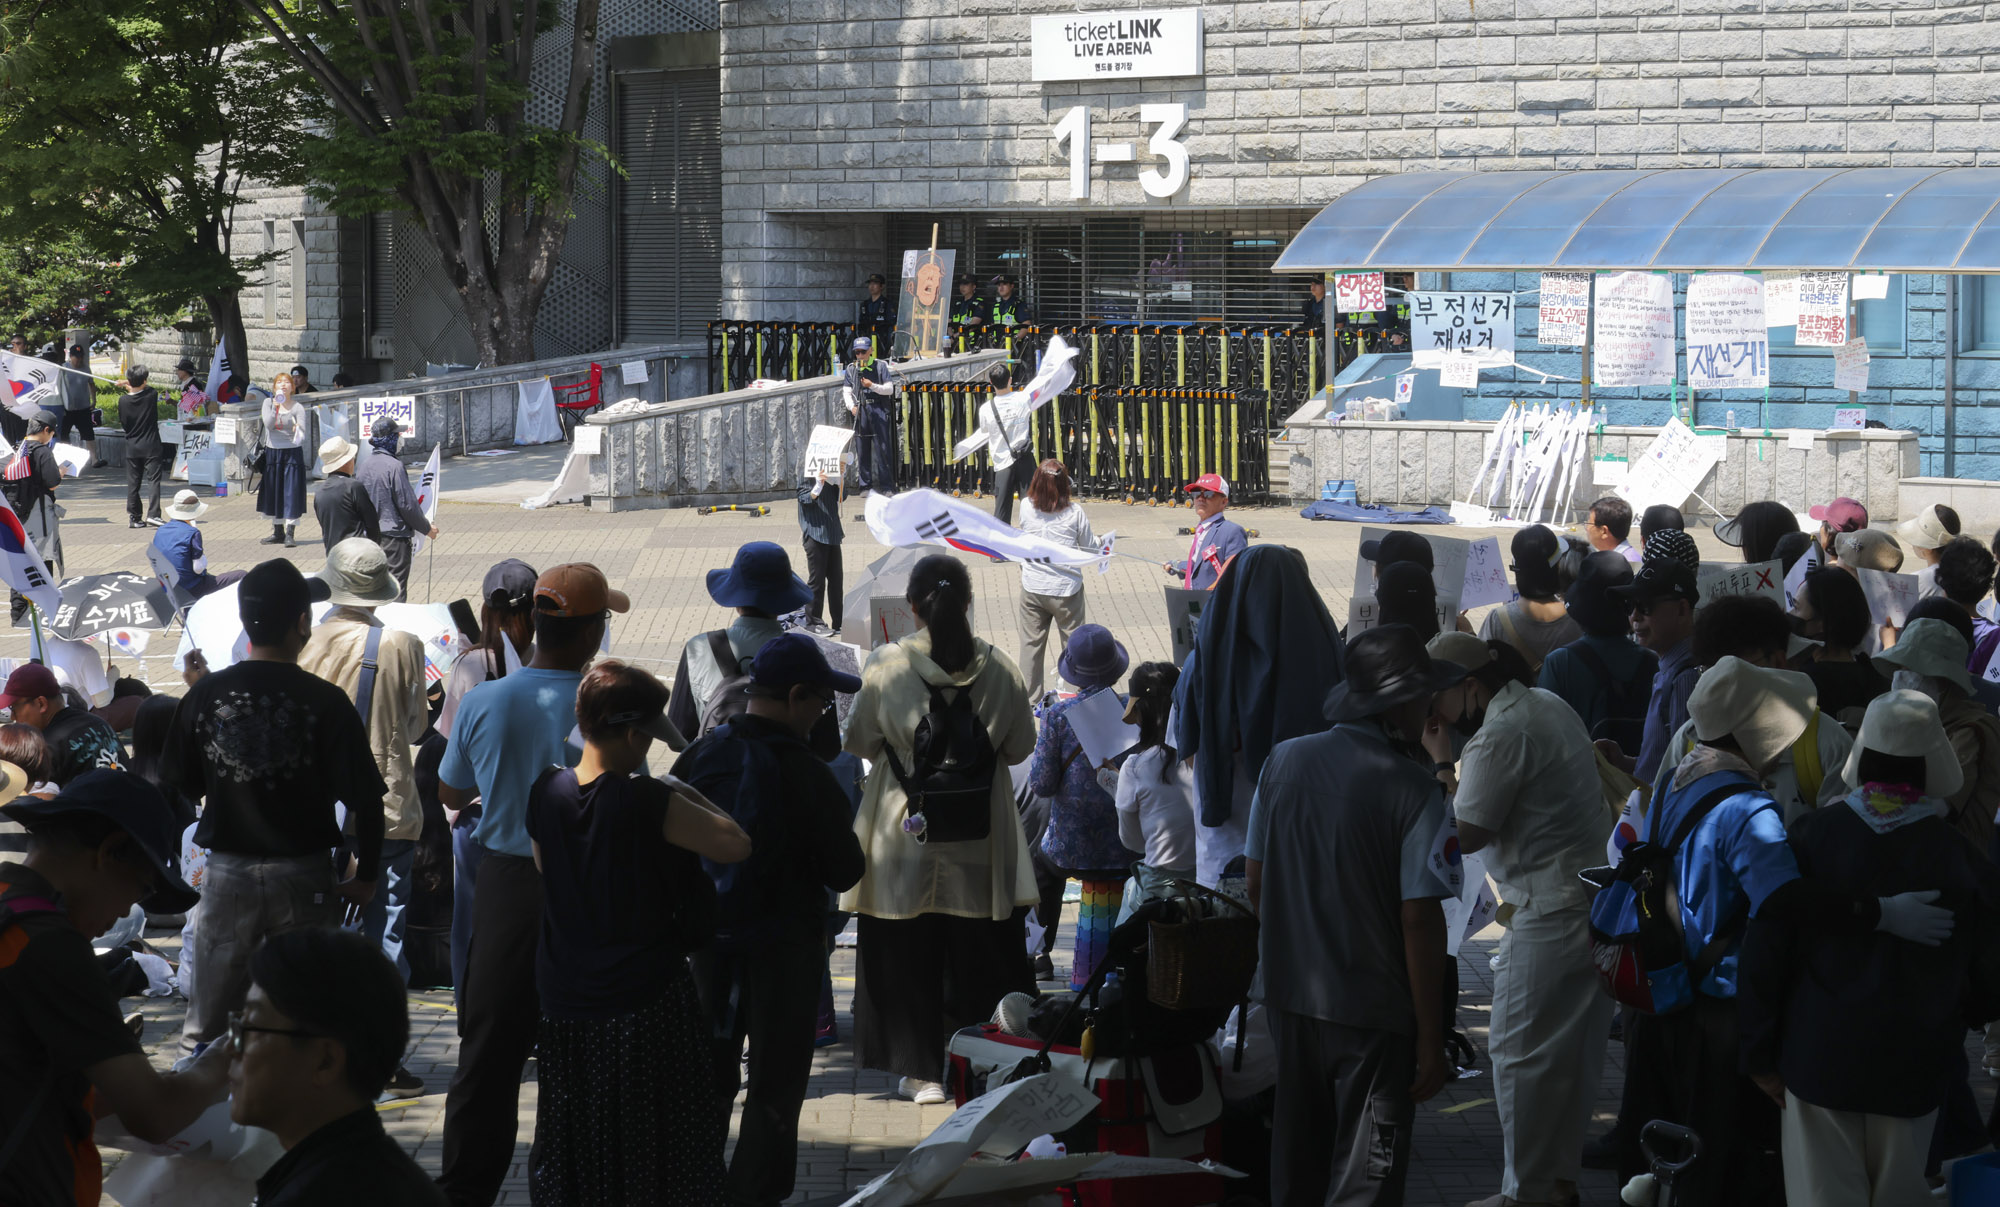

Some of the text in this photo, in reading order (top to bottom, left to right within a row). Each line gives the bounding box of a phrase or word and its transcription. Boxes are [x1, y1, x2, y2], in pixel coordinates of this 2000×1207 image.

[1065, 18, 1163, 42] ticketLINK
[1074, 41, 1153, 57] LIVE ARENA
[1095, 61, 1133, 72] 핸드볼 경기장
[1052, 102, 1190, 198] 1-3
[1359, 293, 1385, 310] D-8
[1433, 327, 1493, 354] 재선거
[1688, 340, 1766, 379] 재선거!
[1690, 378, 1720, 388] FREEDOM
[807, 455, 839, 476] 수개표
[82, 600, 153, 630] 수개표
